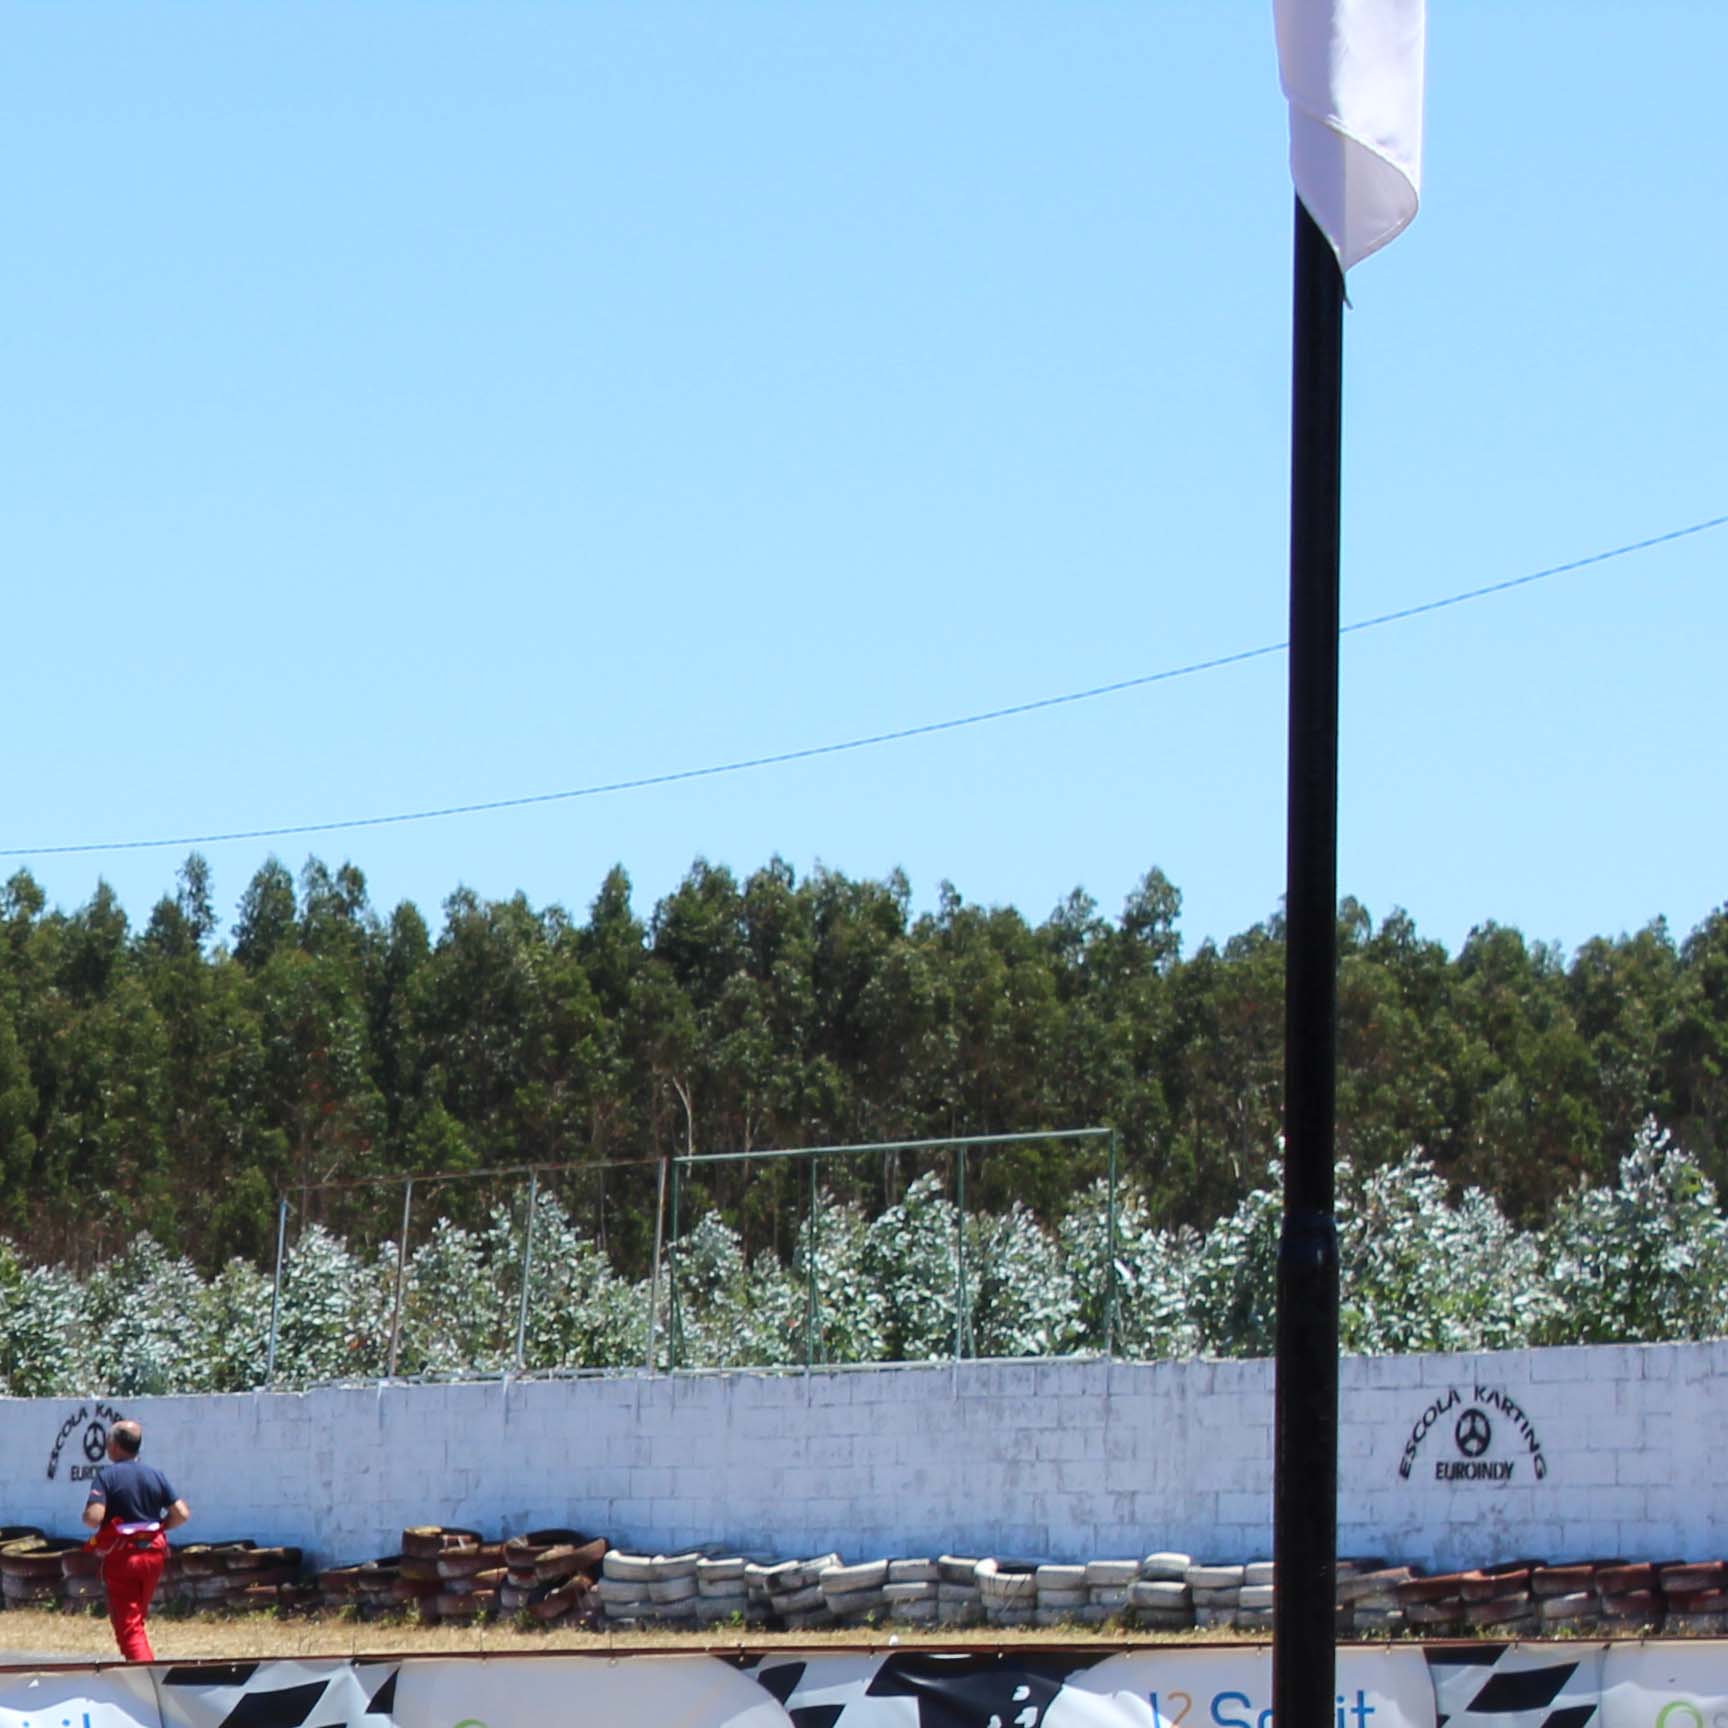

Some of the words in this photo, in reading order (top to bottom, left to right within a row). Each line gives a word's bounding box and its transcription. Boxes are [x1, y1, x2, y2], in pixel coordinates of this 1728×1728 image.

[1399, 1388, 1462, 1480] ESCOLA
[1473, 1385, 1548, 1480] KARTING
[1435, 1460, 1514, 1480] EUROINDY
